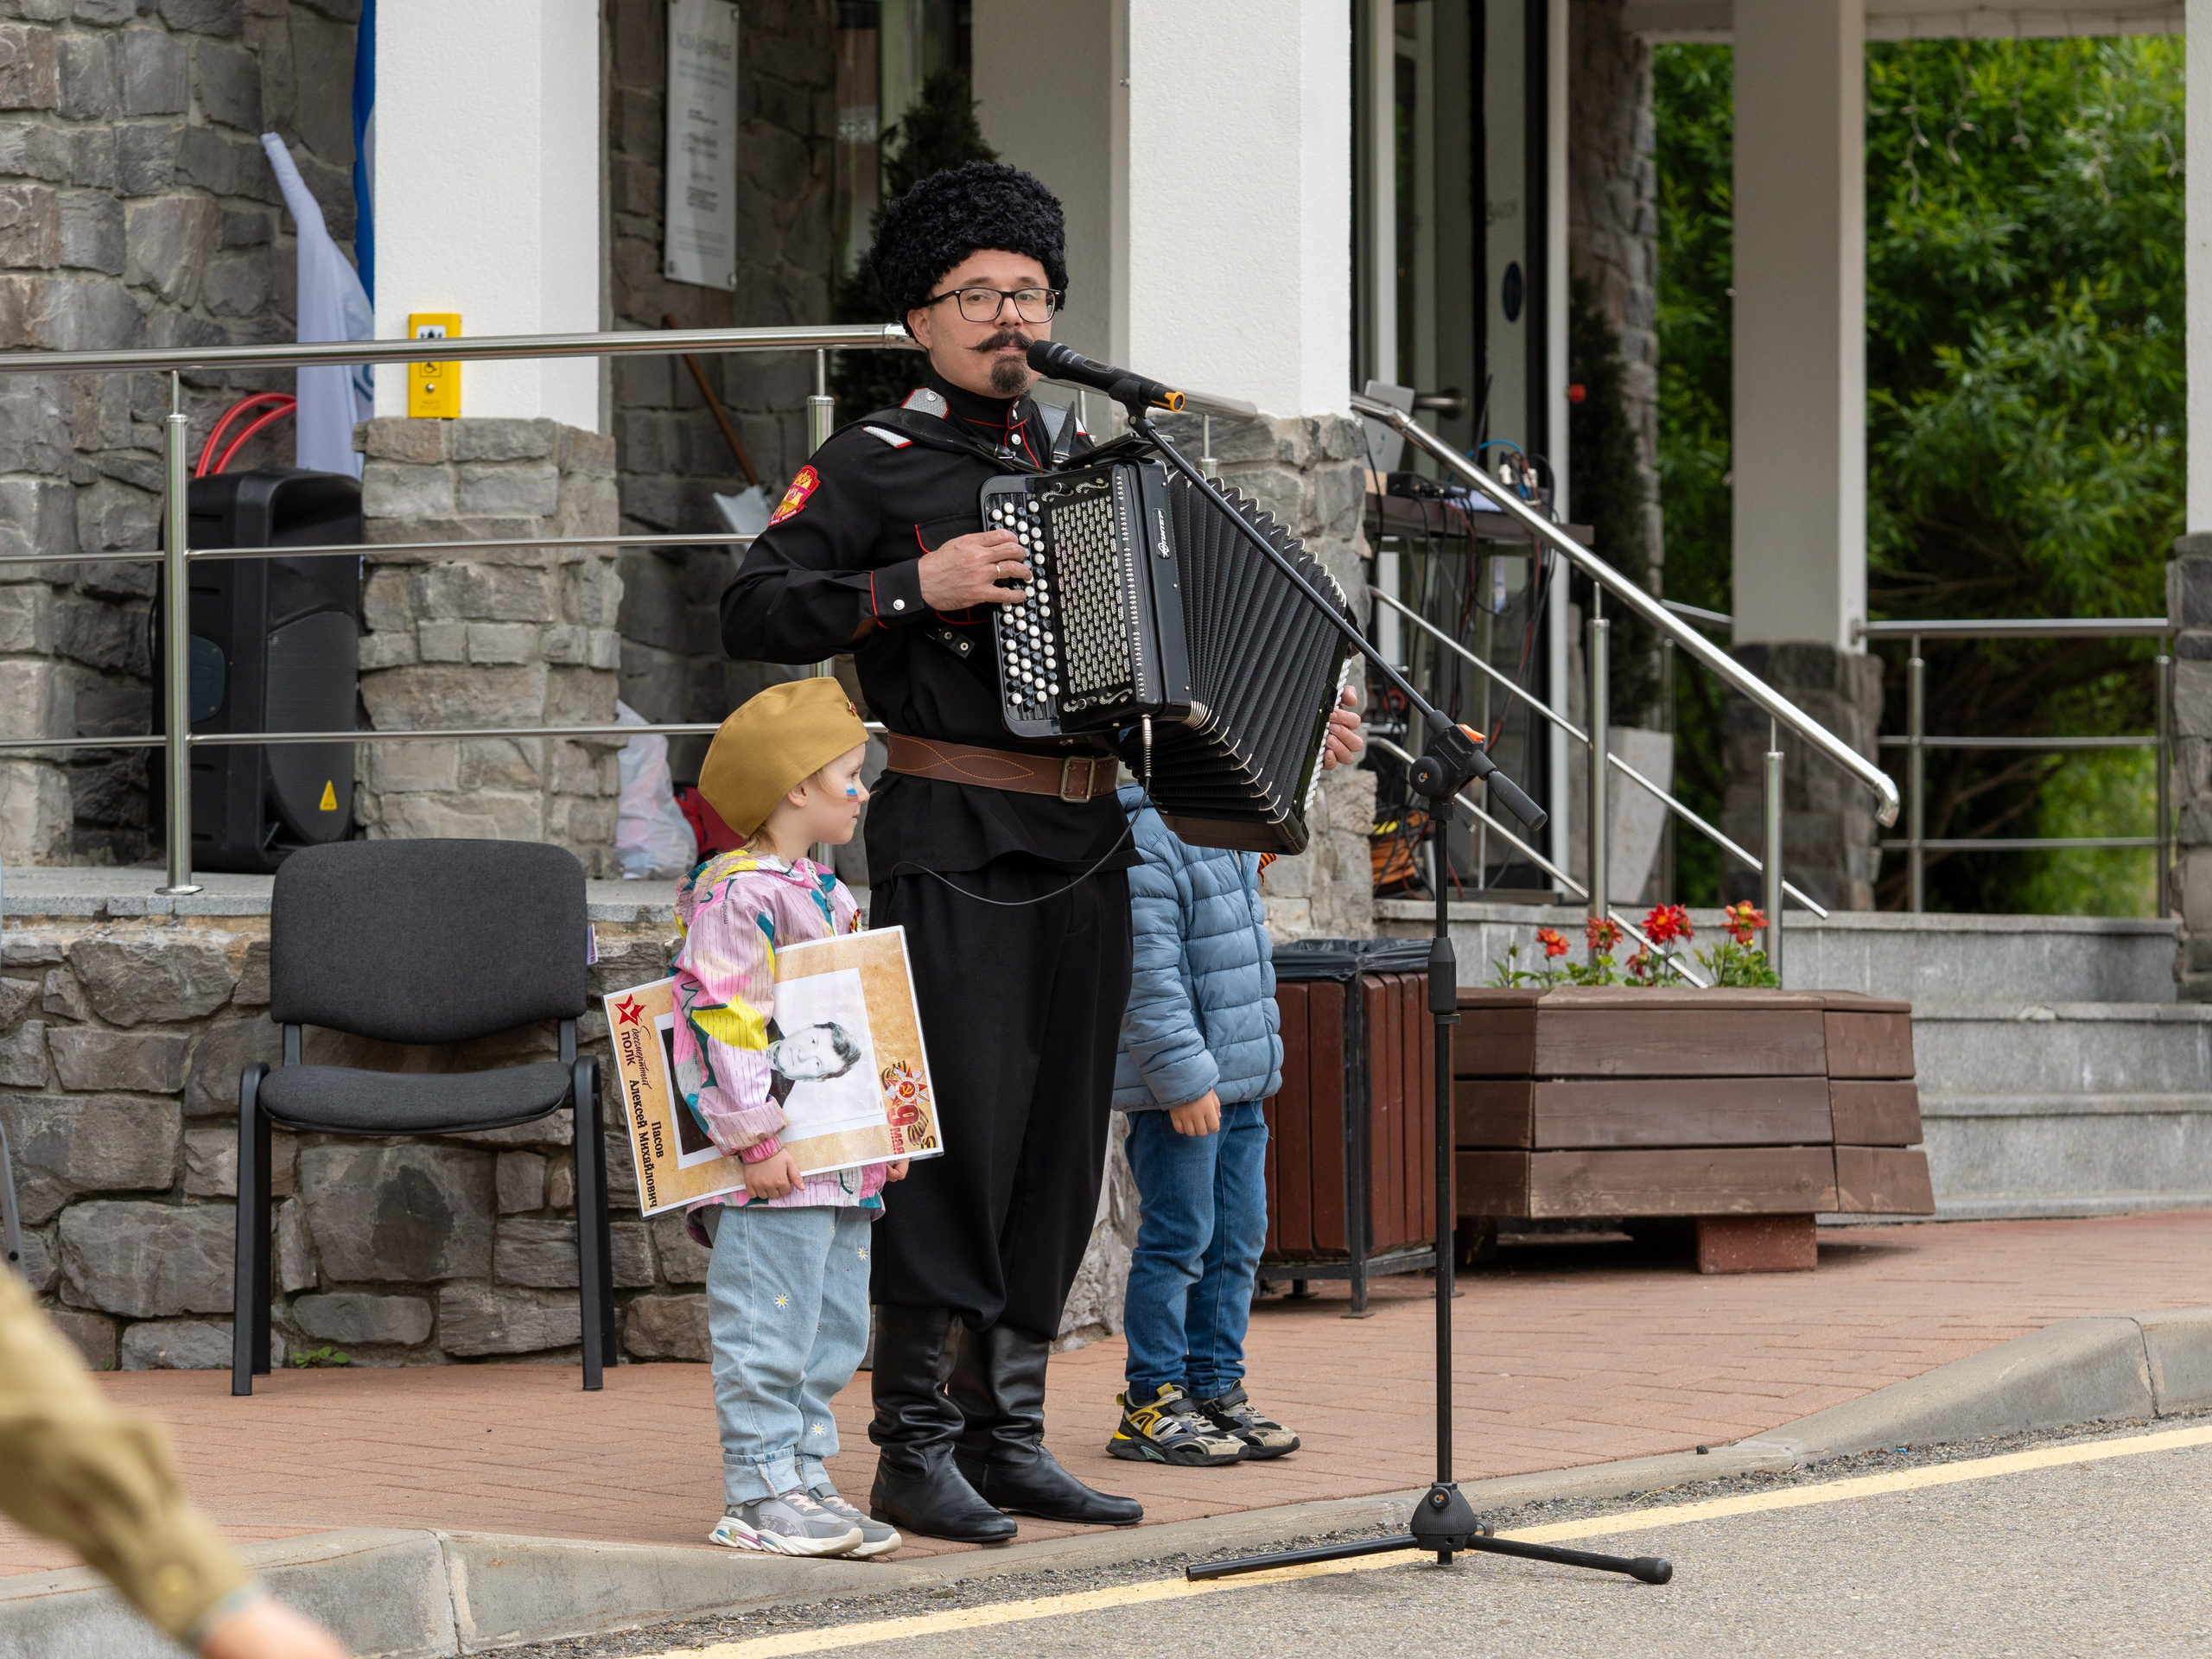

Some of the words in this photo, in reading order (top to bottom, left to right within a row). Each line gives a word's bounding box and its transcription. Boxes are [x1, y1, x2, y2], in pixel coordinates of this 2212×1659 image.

[620, 1031, 635, 1066] ПОЛК
[887, 1104, 920, 1127] 9
[629, 1080, 647, 1129] Алексей
[639, 1132, 658, 1209] Михайлович
[651, 1121, 664, 1159] Пасов
